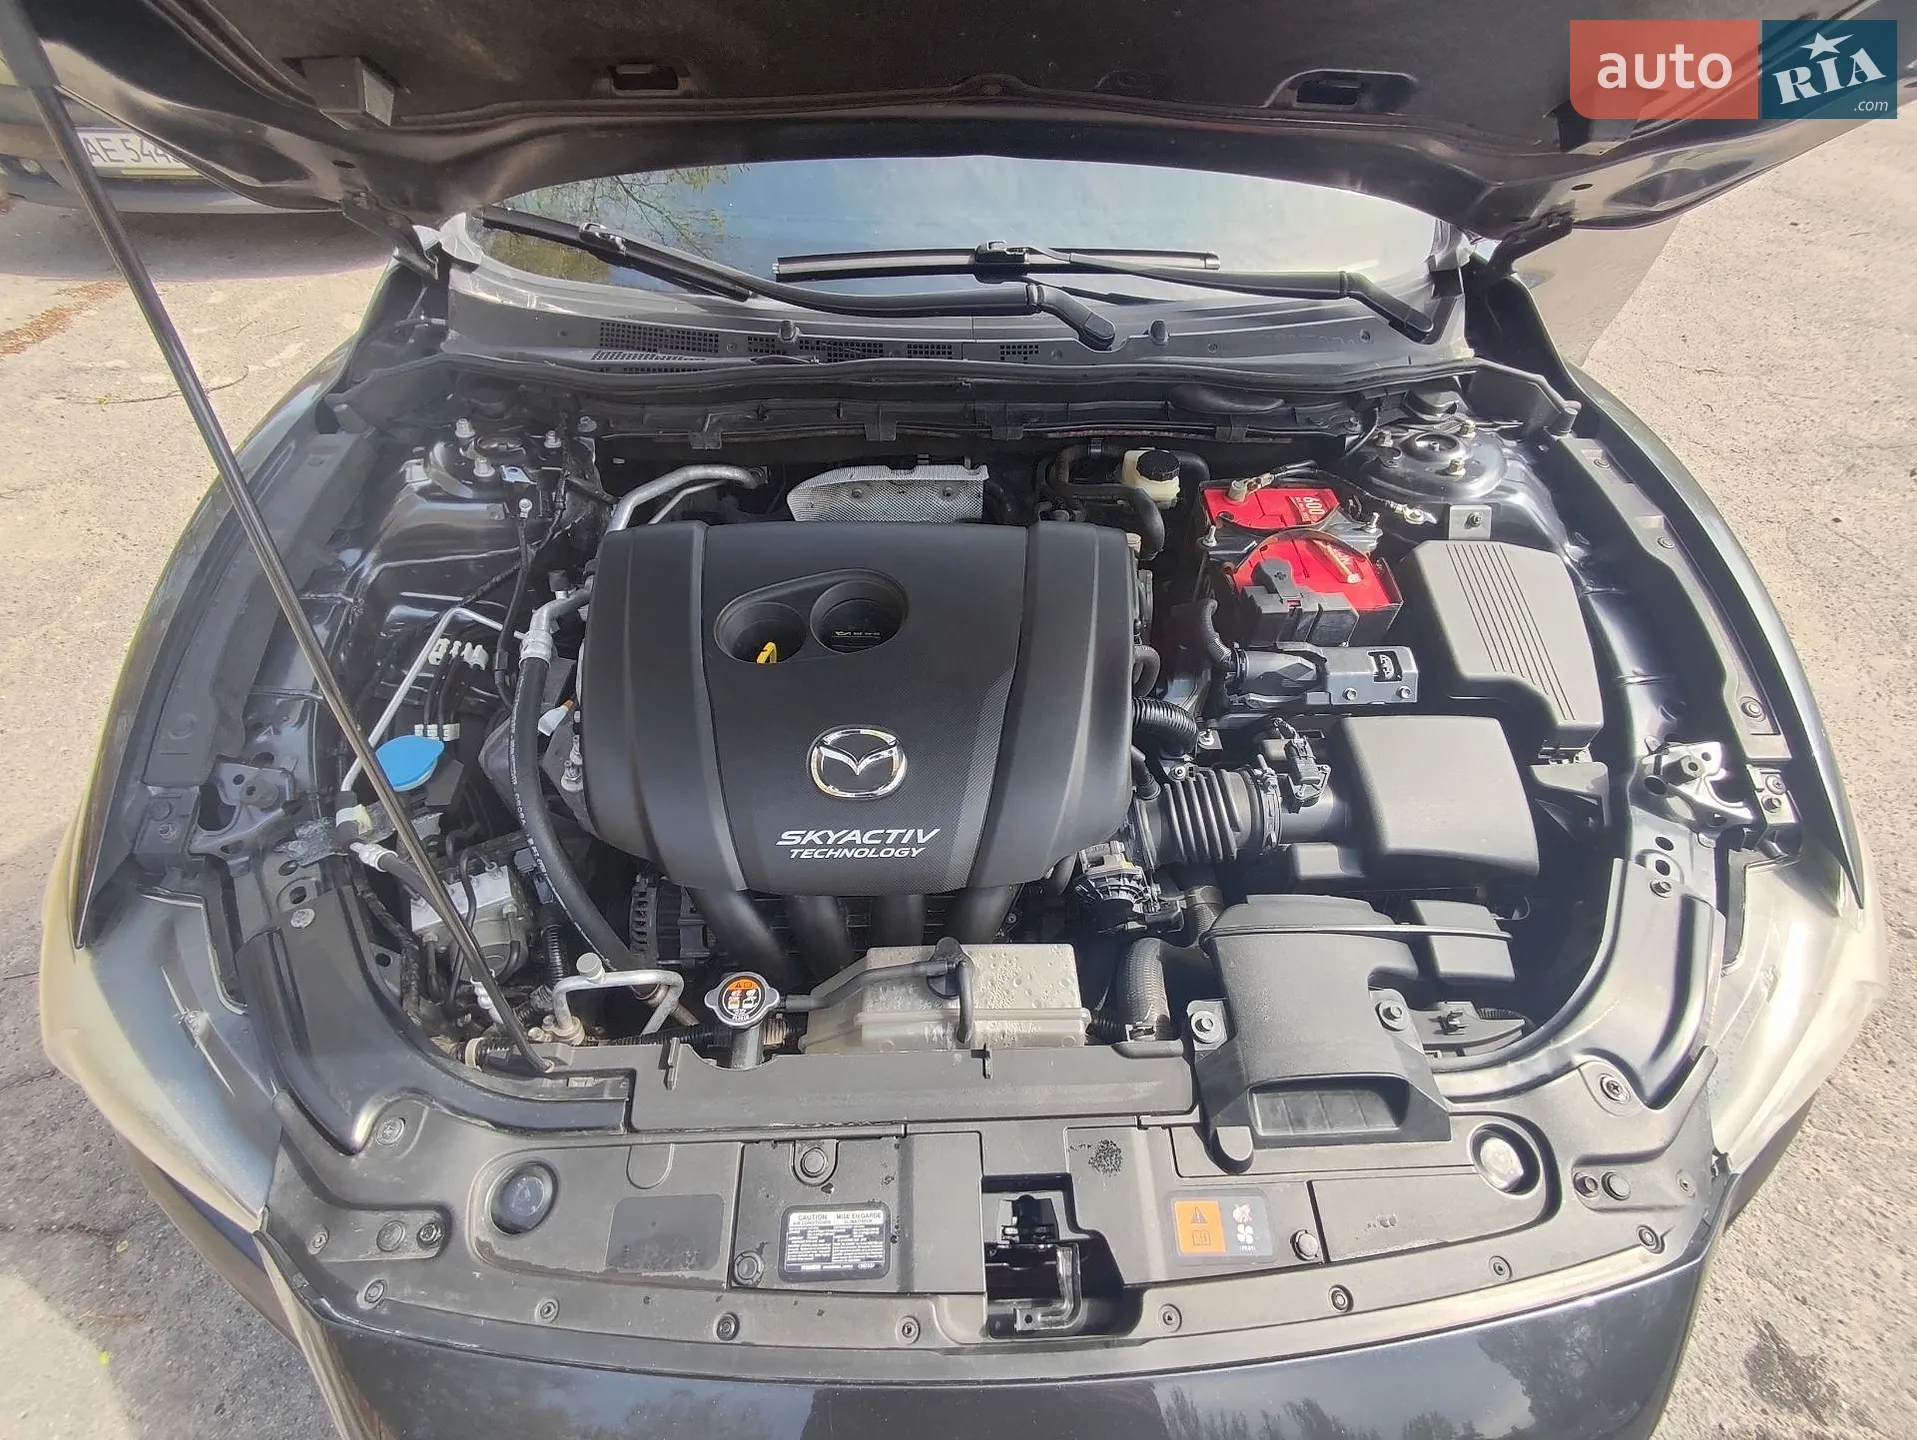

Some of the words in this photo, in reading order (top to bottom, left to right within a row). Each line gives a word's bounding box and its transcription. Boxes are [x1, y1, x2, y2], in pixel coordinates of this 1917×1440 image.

[120, 138, 178, 164] 544
[1303, 496, 1326, 515] 600
[776, 829, 940, 845] SKYACTIV
[790, 848, 926, 859] TECHNOLOGY
